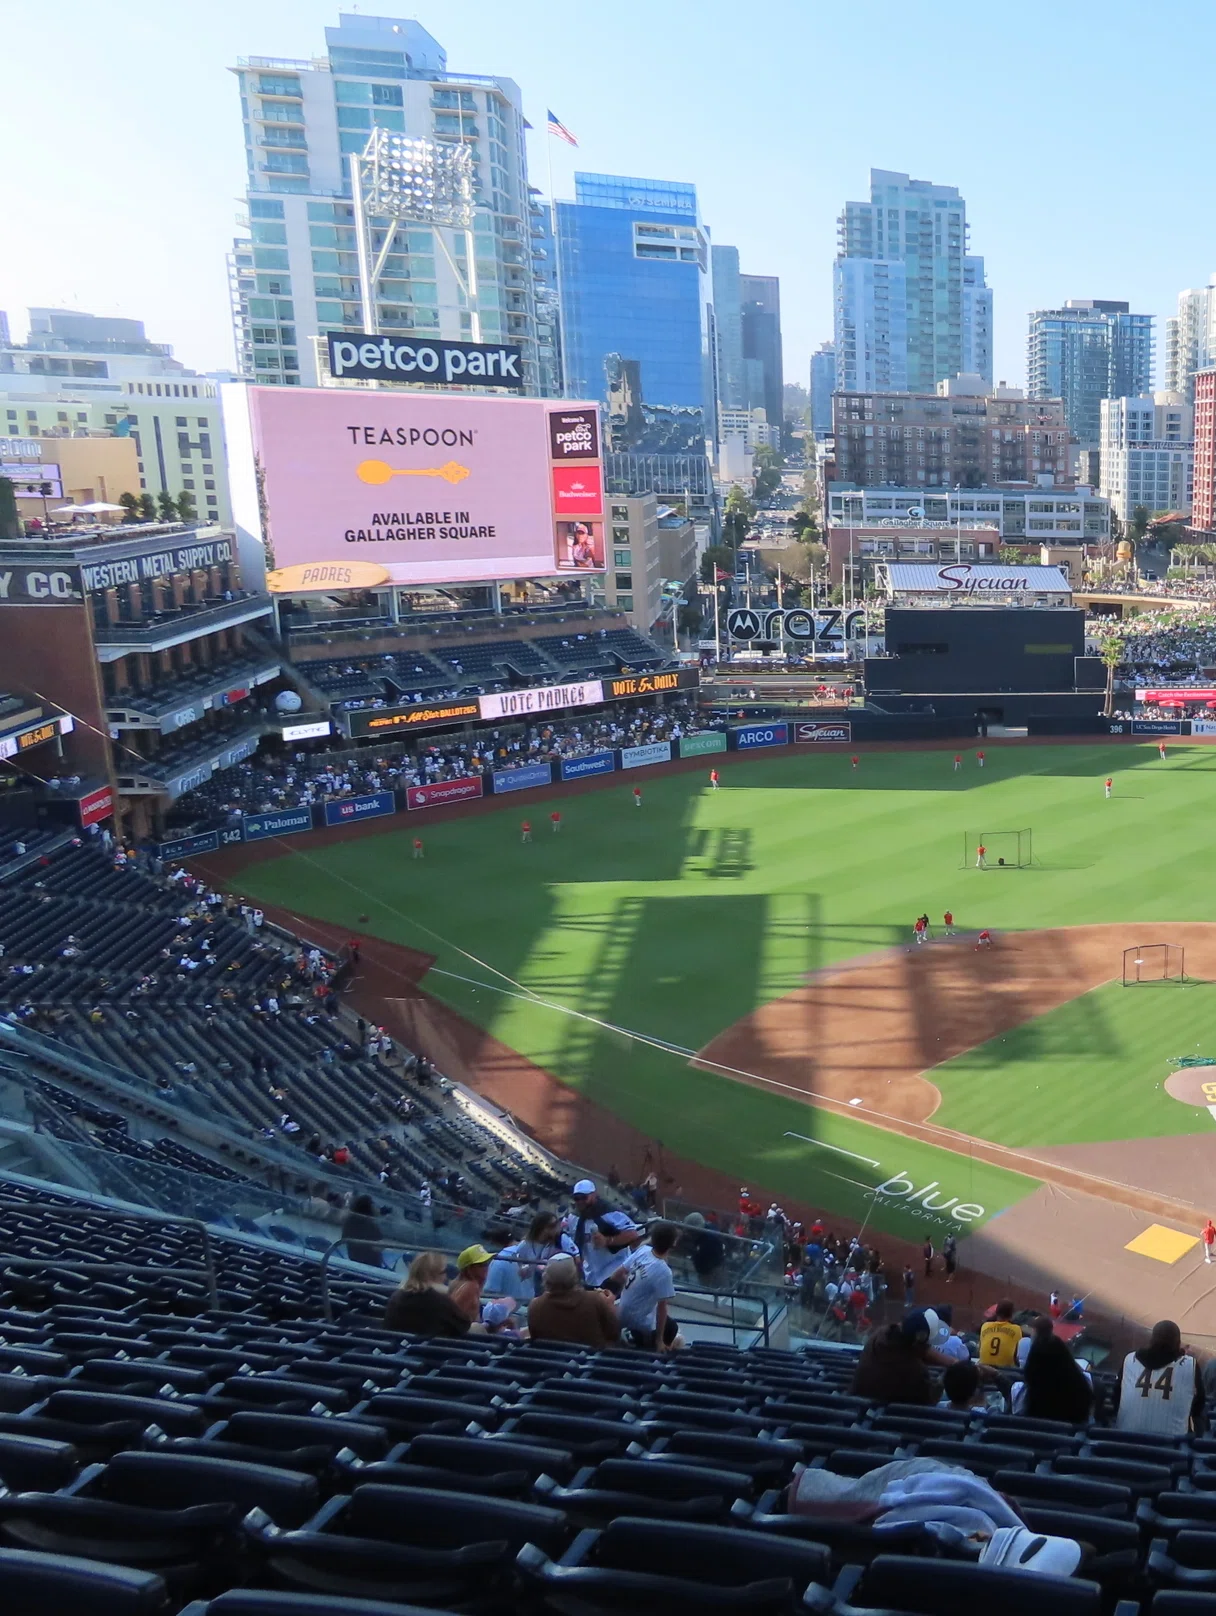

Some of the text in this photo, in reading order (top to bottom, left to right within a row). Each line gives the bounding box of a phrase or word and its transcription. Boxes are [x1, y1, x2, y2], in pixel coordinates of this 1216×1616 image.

[333, 338, 520, 381] petco park
[347, 426, 474, 447] TEASPOON
[556, 431, 592, 444] petco
[563, 441, 592, 454] park
[371, 511, 470, 526] AVAILABLE IN
[881, 518, 950, 528] Gallagher Square
[344, 525, 496, 543] GALLAGHER SQUARE
[82, 542, 233, 591] WESTERN METAL SUPPLY CO.
[302, 567, 352, 584] PADRES
[936, 564, 1030, 596] Sycuan
[26, 572, 82, 599] CO.
[764, 609, 867, 641] razr
[612, 679, 636, 696] VOTE
[654, 673, 679, 690] DAILY
[500, 686, 584, 714] VOTE PADRES
[440, 707, 463, 718] BALLOT
[463, 705, 477, 715] 2025
[738, 730, 774, 744] ARCO
[799, 723, 845, 740] Sycuan
[1110, 725, 1123, 734] 396
[565, 759, 605, 775] Southwest
[430, 784, 476, 799] Snapdragon
[355, 800, 380, 813] bank
[264, 815, 309, 830] Palomar
[223, 829, 241, 843] 342
[875, 1171, 985, 1222] blue
[863, 1192, 962, 1231] CALIFORNIA
[990, 1337, 1001, 1356] 9
[1135, 1366, 1174, 1400] 44
